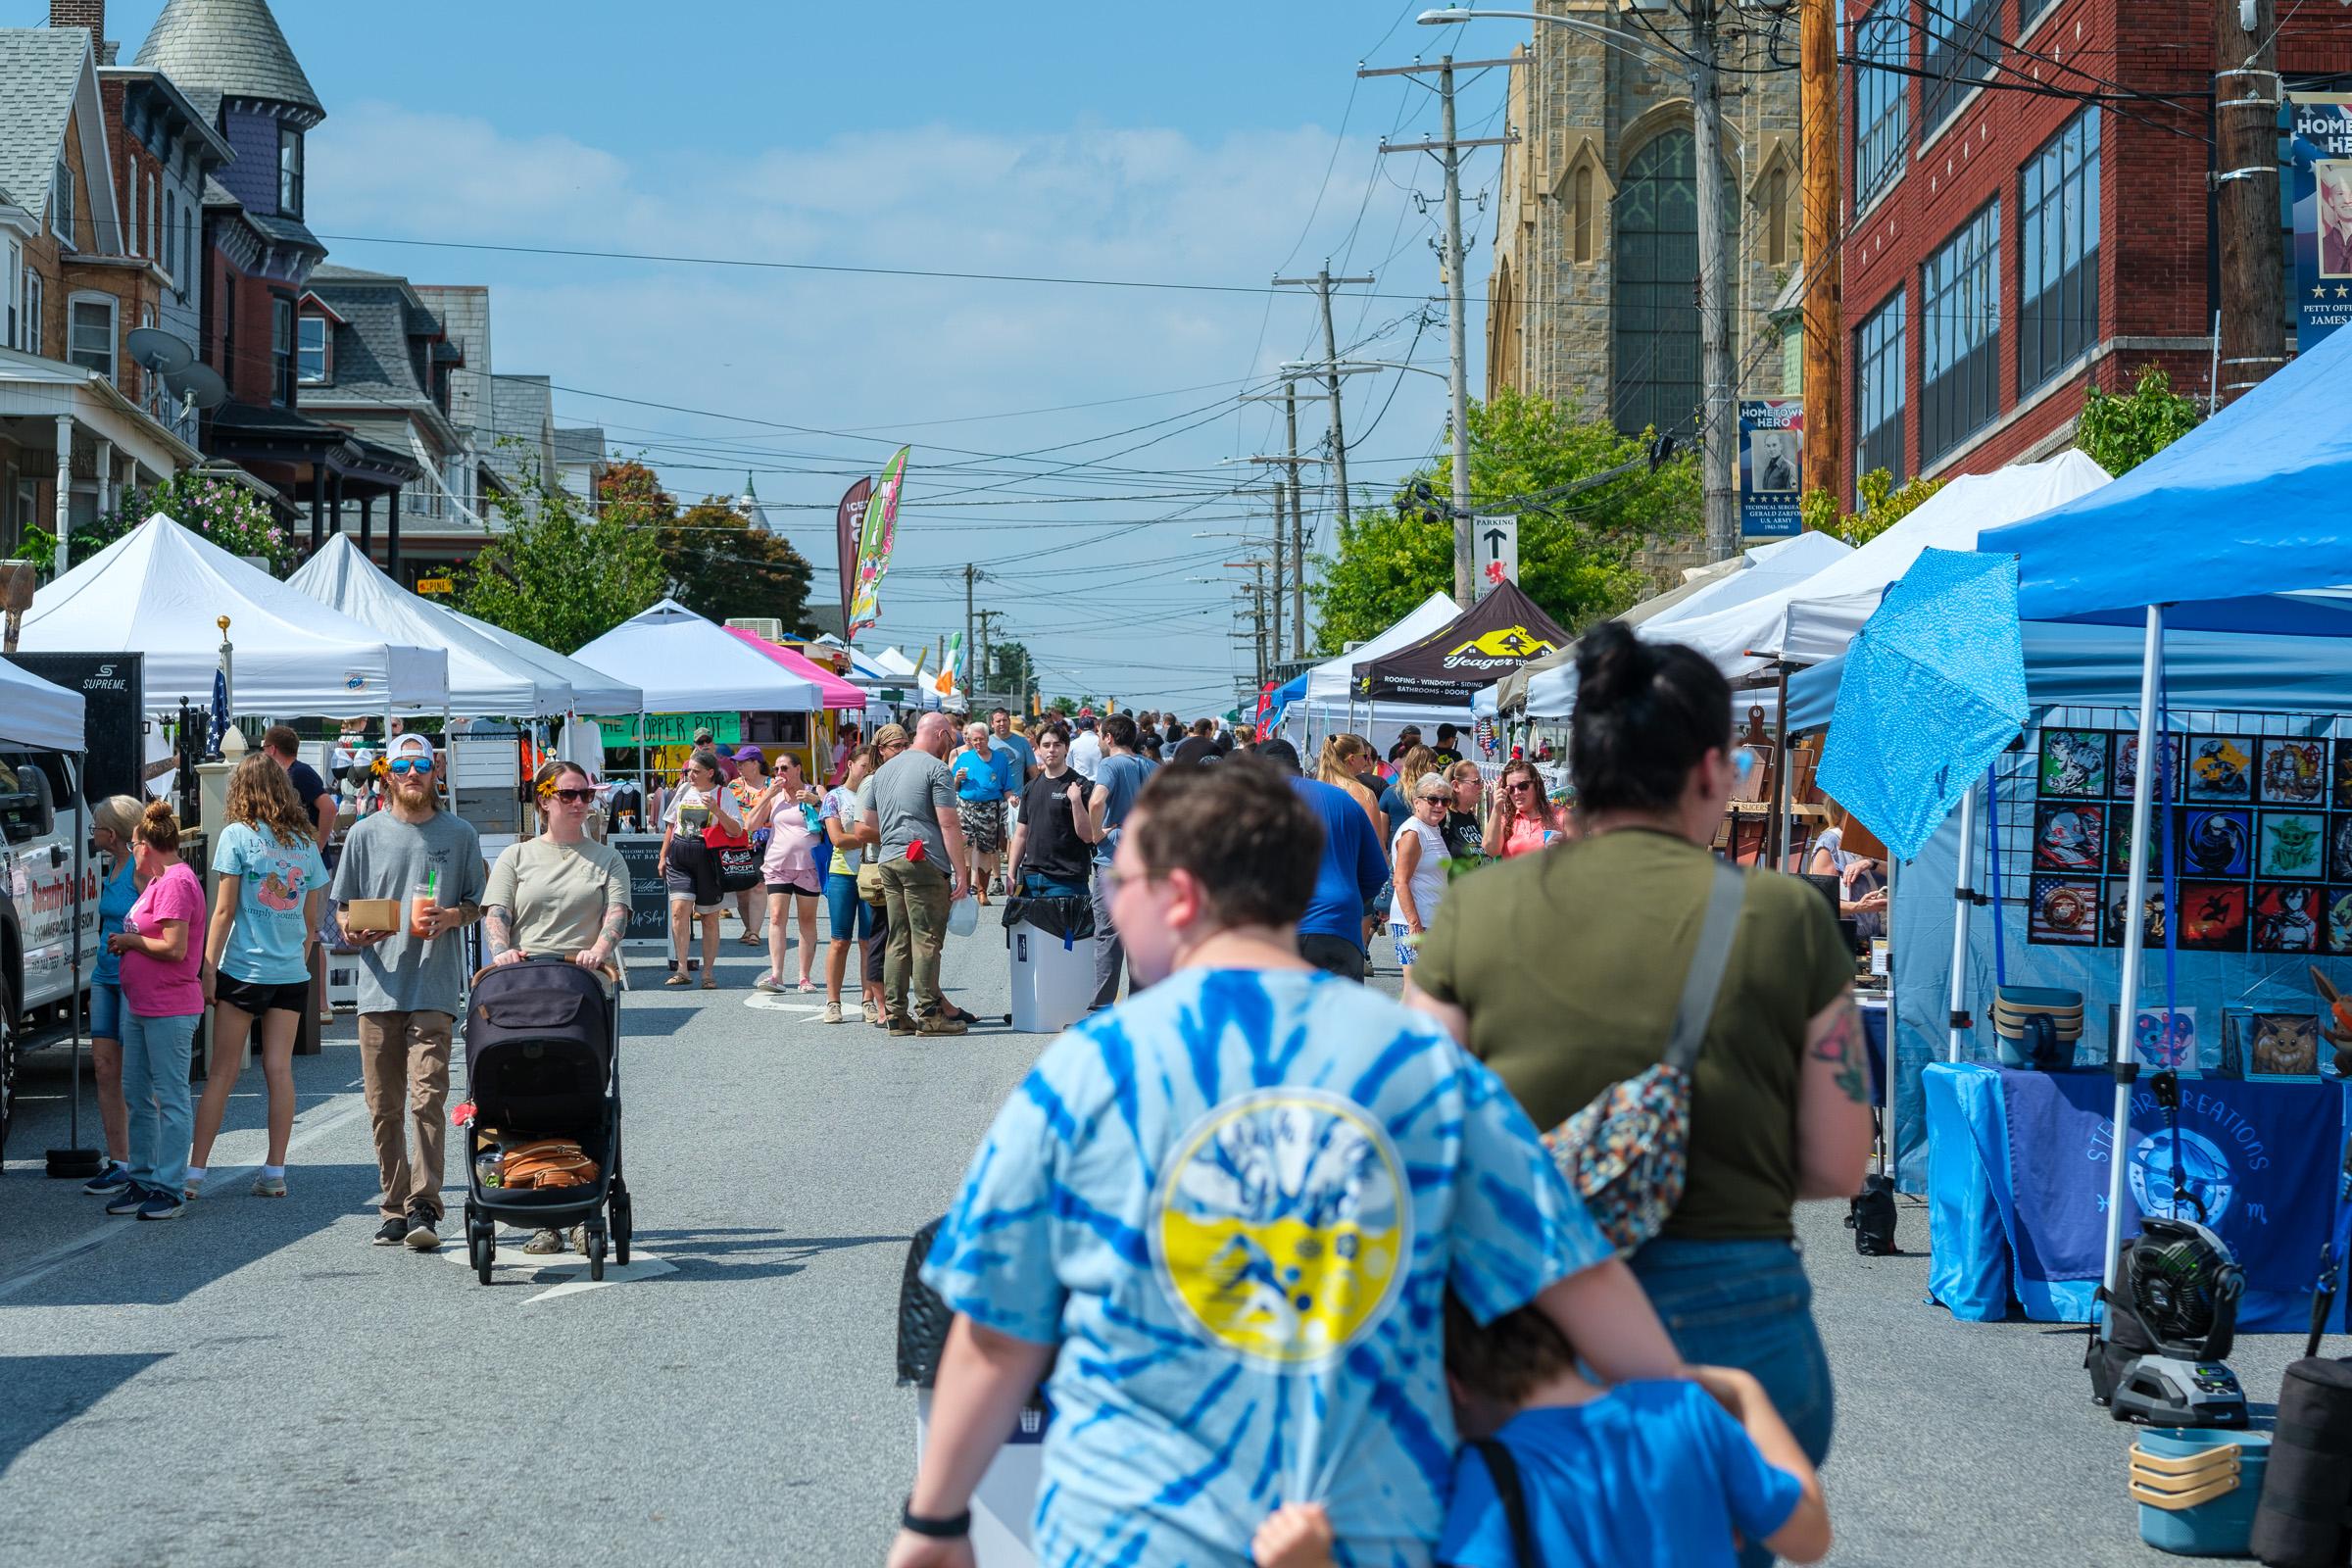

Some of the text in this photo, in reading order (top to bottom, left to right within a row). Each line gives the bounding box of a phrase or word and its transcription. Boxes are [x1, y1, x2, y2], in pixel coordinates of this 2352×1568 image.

[2303, 304, 2330, 313] PETTY
[2311, 316, 2348, 325] JAMES
[1757, 417, 1791, 427] HERO
[1443, 656, 1514, 670] Yeager
[82, 678, 126, 690] SUPREME
[1384, 675, 1416, 685] ROOFING
[1421, 678, 1455, 687] WINDOWS
[1396, 685, 1440, 695] BATHROOMS
[632, 716, 686, 742] COPPER
[695, 715, 722, 739] POT
[32, 876, 64, 915] Security
[65, 872, 85, 906] Fee
